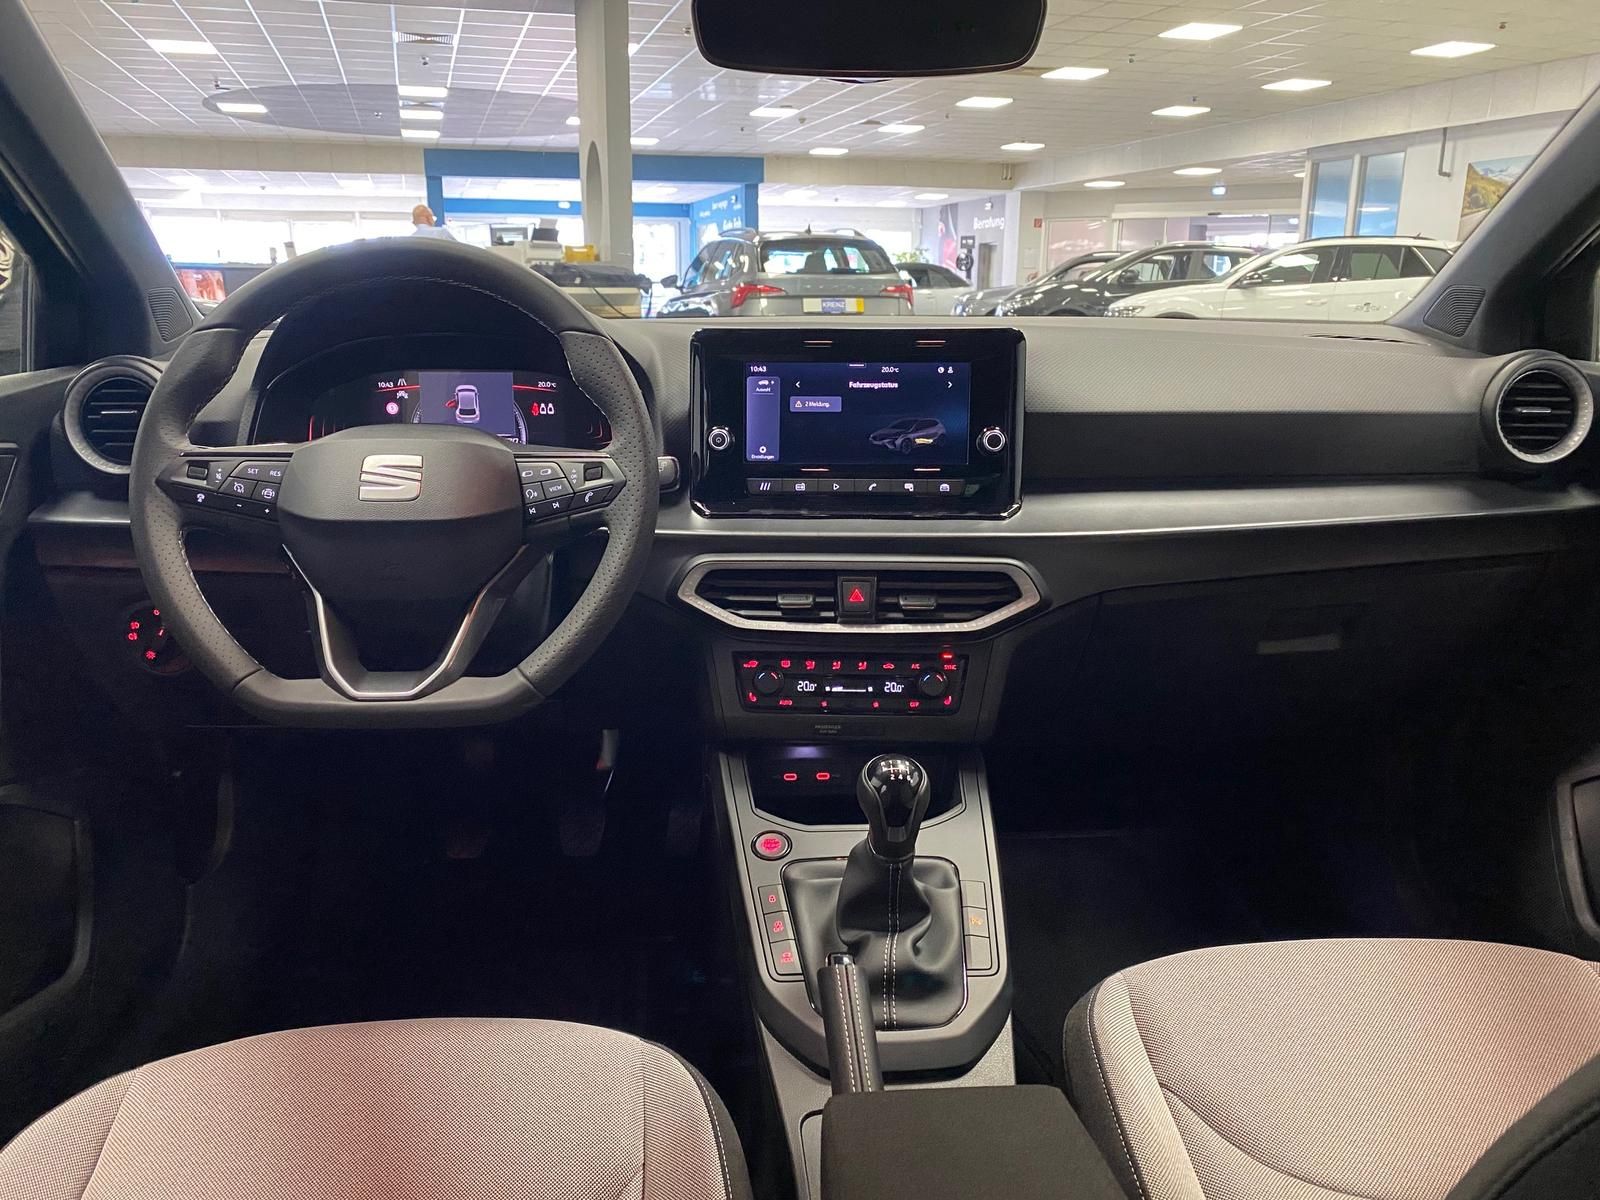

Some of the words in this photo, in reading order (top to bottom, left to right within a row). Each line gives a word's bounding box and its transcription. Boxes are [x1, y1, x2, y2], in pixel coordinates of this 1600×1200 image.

[973, 216, 1005, 230] Beratung
[848, 381, 898, 389] Fahrzeugstatus
[247, 467, 259, 475] SET
[548, 484, 562, 492] VIEW
